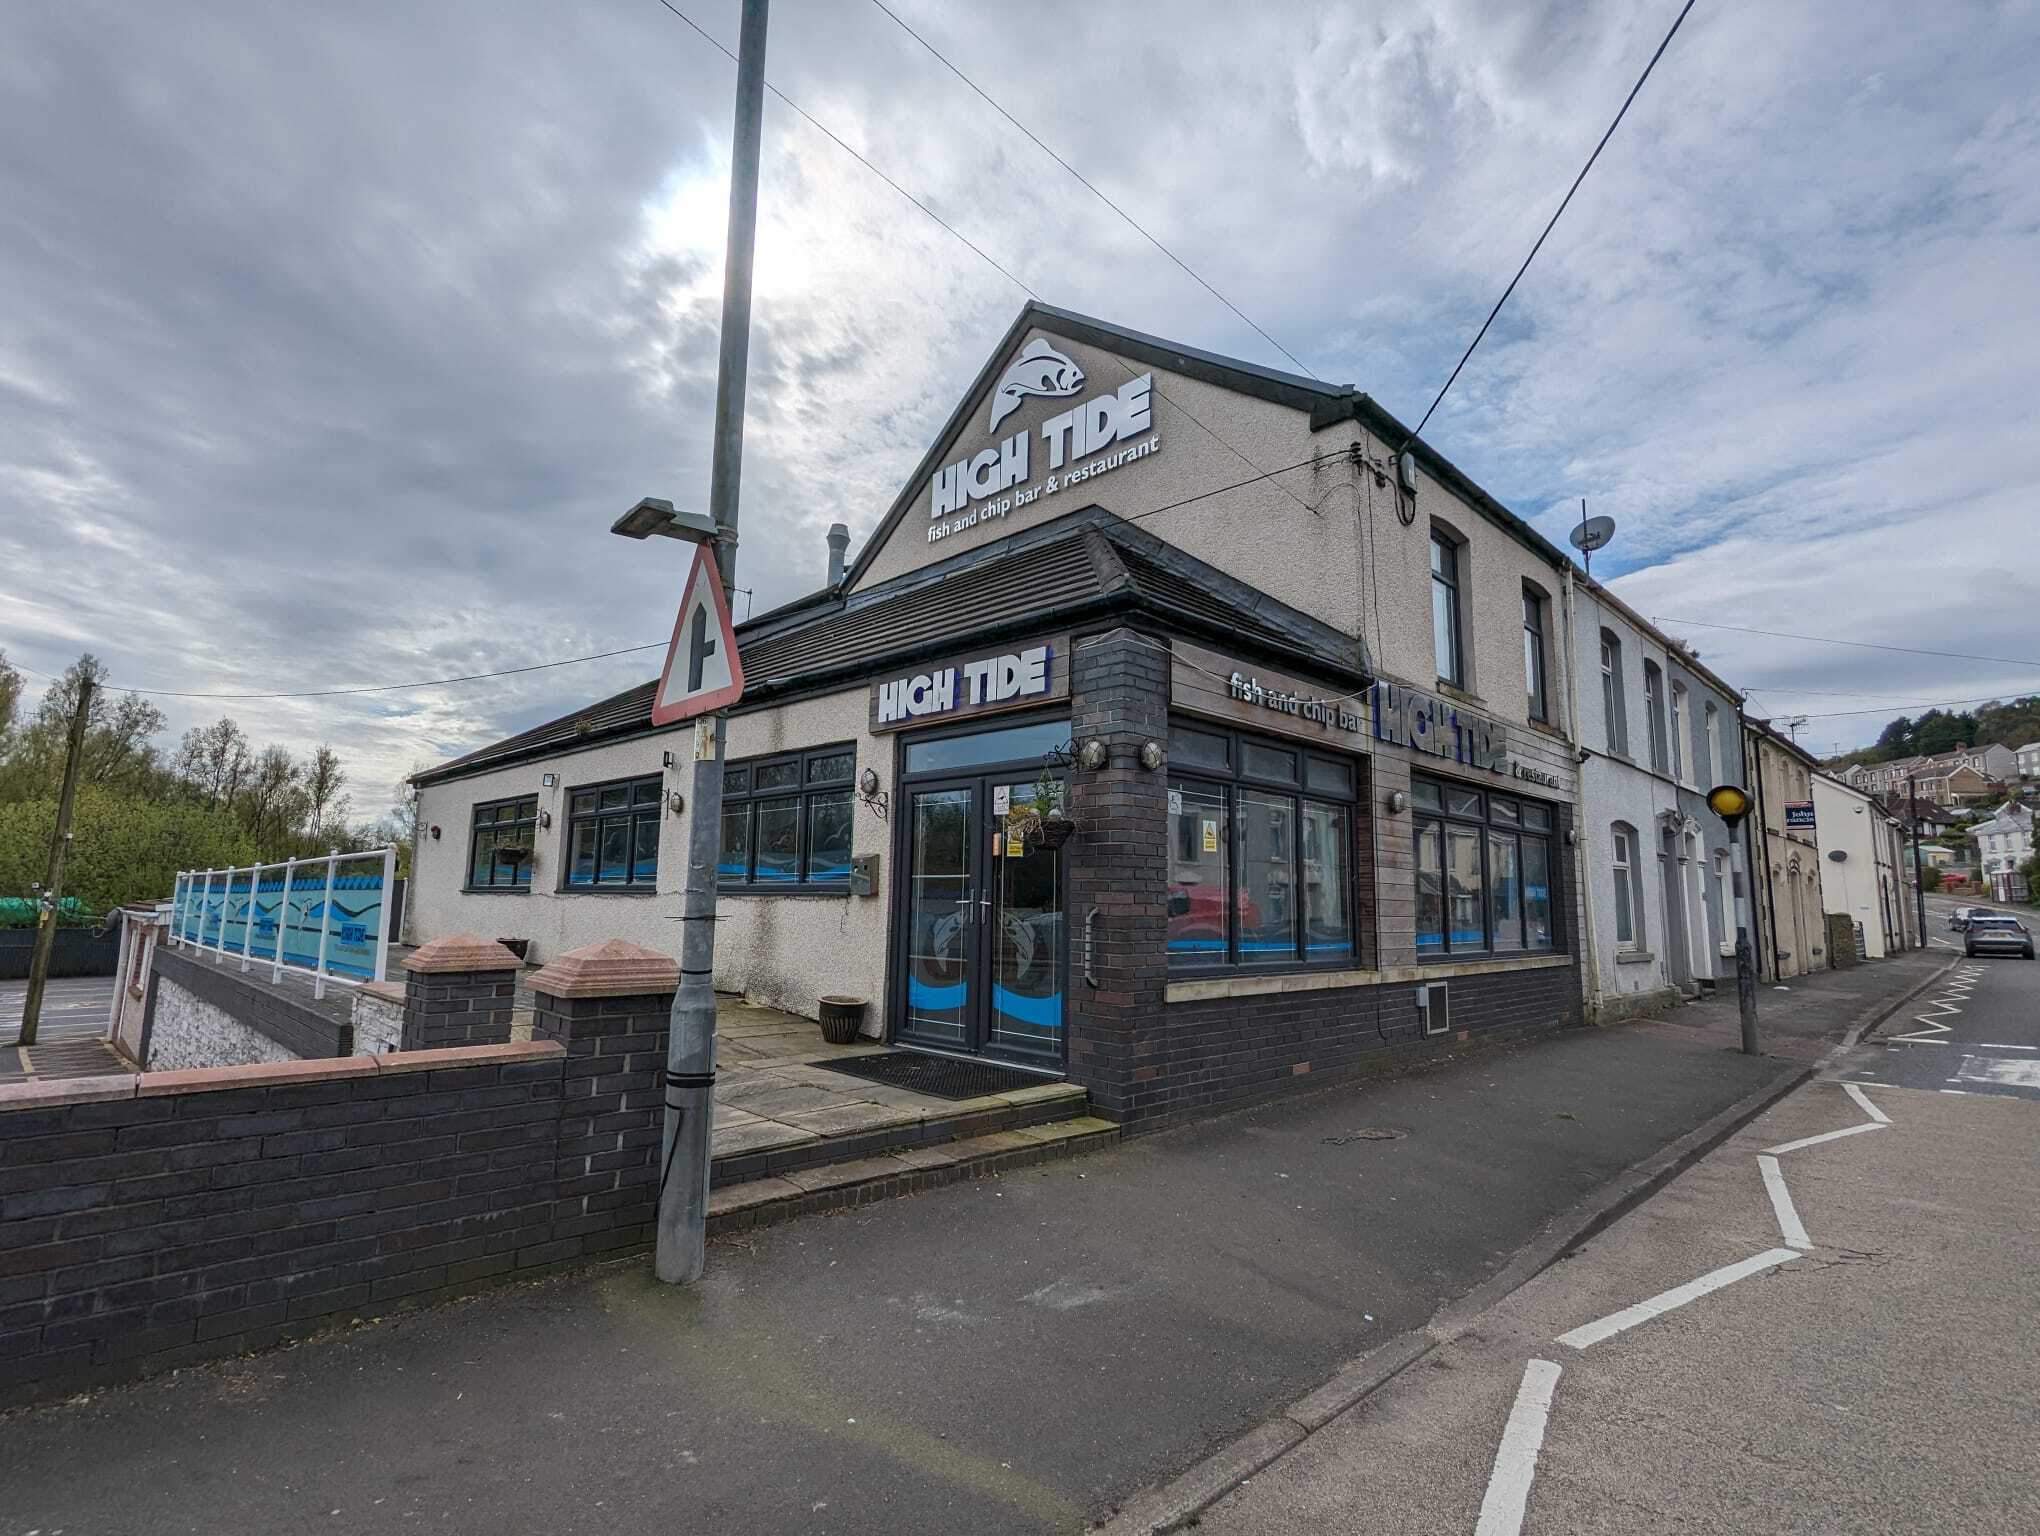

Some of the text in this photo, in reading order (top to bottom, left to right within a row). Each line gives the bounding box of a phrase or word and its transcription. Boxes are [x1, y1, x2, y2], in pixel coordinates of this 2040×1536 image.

[927, 433, 1161, 542] fish and chip bar & restaurant
[931, 372, 1152, 519] HIGH TIDE
[878, 646, 1048, 723] HIGH TIDE
[1231, 672, 1363, 733] fish and chip bar
[1373, 680, 1508, 776] HIGH TIDE
